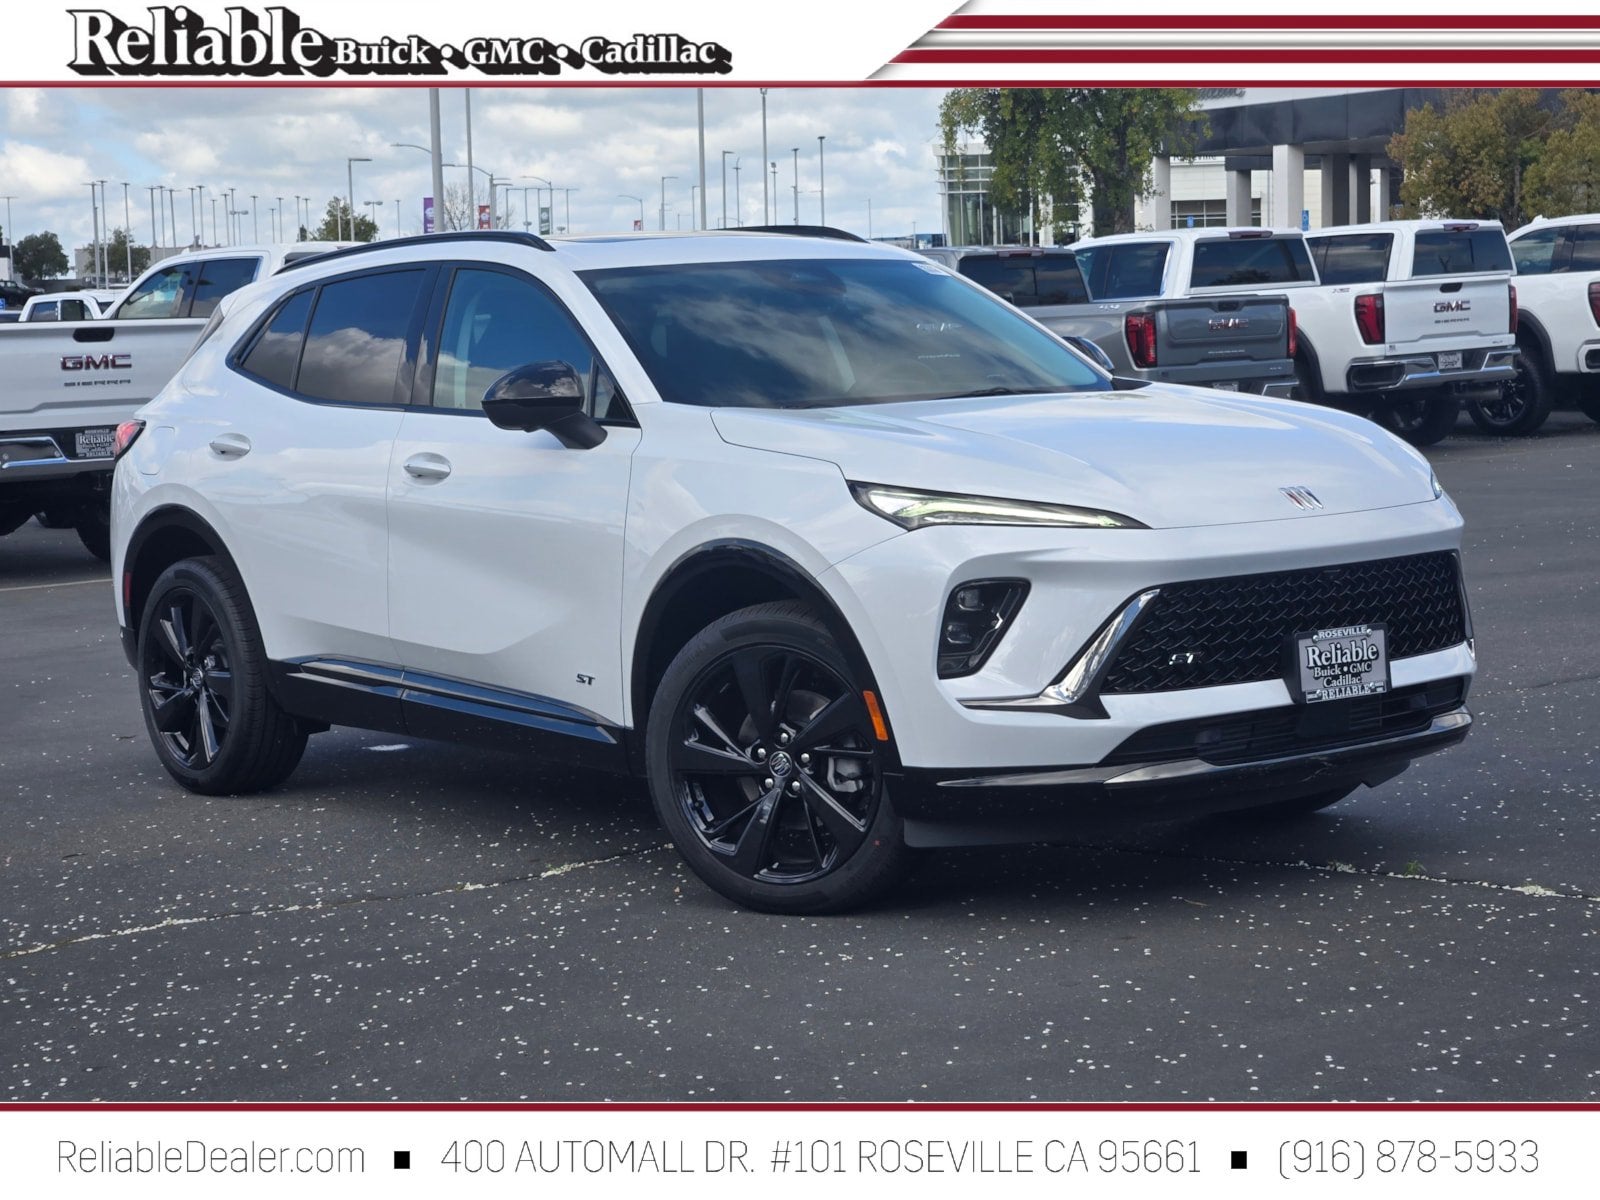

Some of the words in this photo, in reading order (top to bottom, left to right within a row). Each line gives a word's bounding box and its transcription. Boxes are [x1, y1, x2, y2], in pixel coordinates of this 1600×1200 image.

[1434, 300, 1471, 313] GMC
[61, 354, 132, 370] GMC
[1318, 626, 1368, 639] ROSEVILLE
[1307, 638, 1378, 668] Reliable
[1314, 664, 1342, 678] Buick
[1349, 661, 1372, 674] GMC
[576, 673, 596, 686] ST
[1323, 675, 1362, 688] Cadillac
[1321, 684, 1371, 700] RELIABLE
